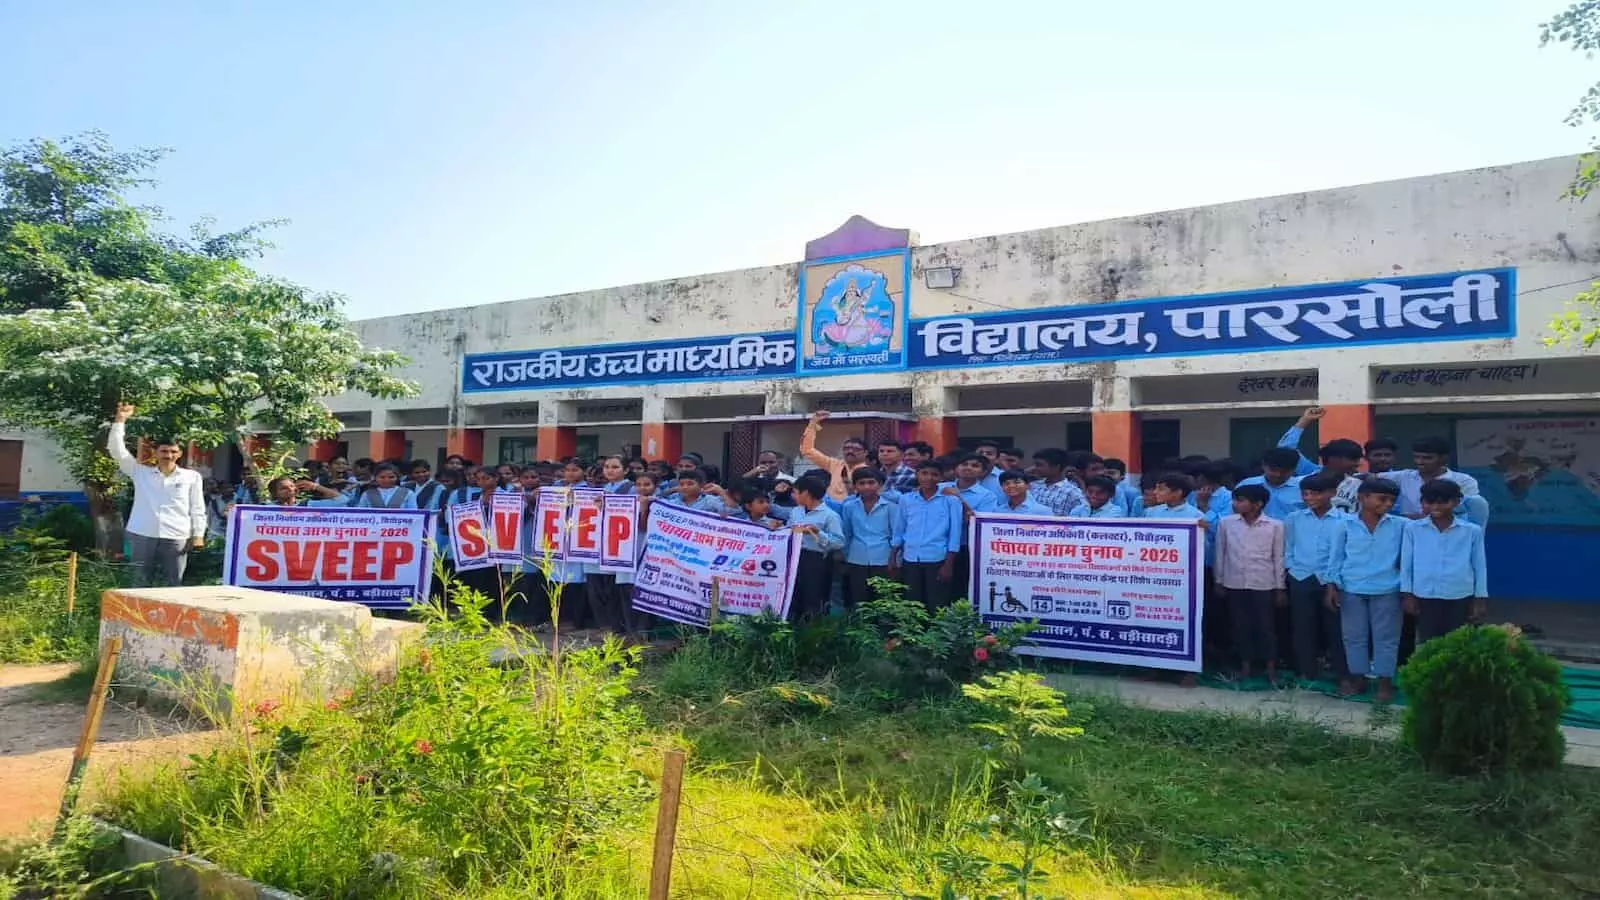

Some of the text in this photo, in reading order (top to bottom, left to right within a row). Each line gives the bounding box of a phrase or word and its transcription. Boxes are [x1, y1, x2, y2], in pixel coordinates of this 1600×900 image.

[917, 273, 1500, 357] विद्यालय, पारसोली
[472, 335, 795, 386] राजकीय उच्च माध्यमिक
[810, 357, 831, 366] जय
[847, 350, 889, 365] सरस्वती
[256, 524, 300, 537] पंचायत
[301, 525, 330, 537] आम
[334, 526, 369, 540] चुनाव
[380, 527, 409, 538] 2026
[457, 519, 486, 557] S
[494, 512, 519, 551] V
[544, 510, 560, 550] E
[577, 508, 598, 549] E
[608, 515, 631, 557] P
[692, 531, 714, 546] आम
[715, 537, 746, 552] चुनाव
[991, 526, 1014, 537] जिला
[1015, 527, 1046, 538] निर्वाचन
[1047, 528, 1084, 540] अधिकारी
[245, 539, 414, 582] SVEEP
[990, 538, 1040, 556] पंचायत
[1041, 543, 1079, 557] आम
[1080, 544, 1124, 563] चुनाव
[1140, 547, 1179, 563] 2026
[1034, 601, 1048, 610] 14
[1111, 606, 1126, 615] 16
